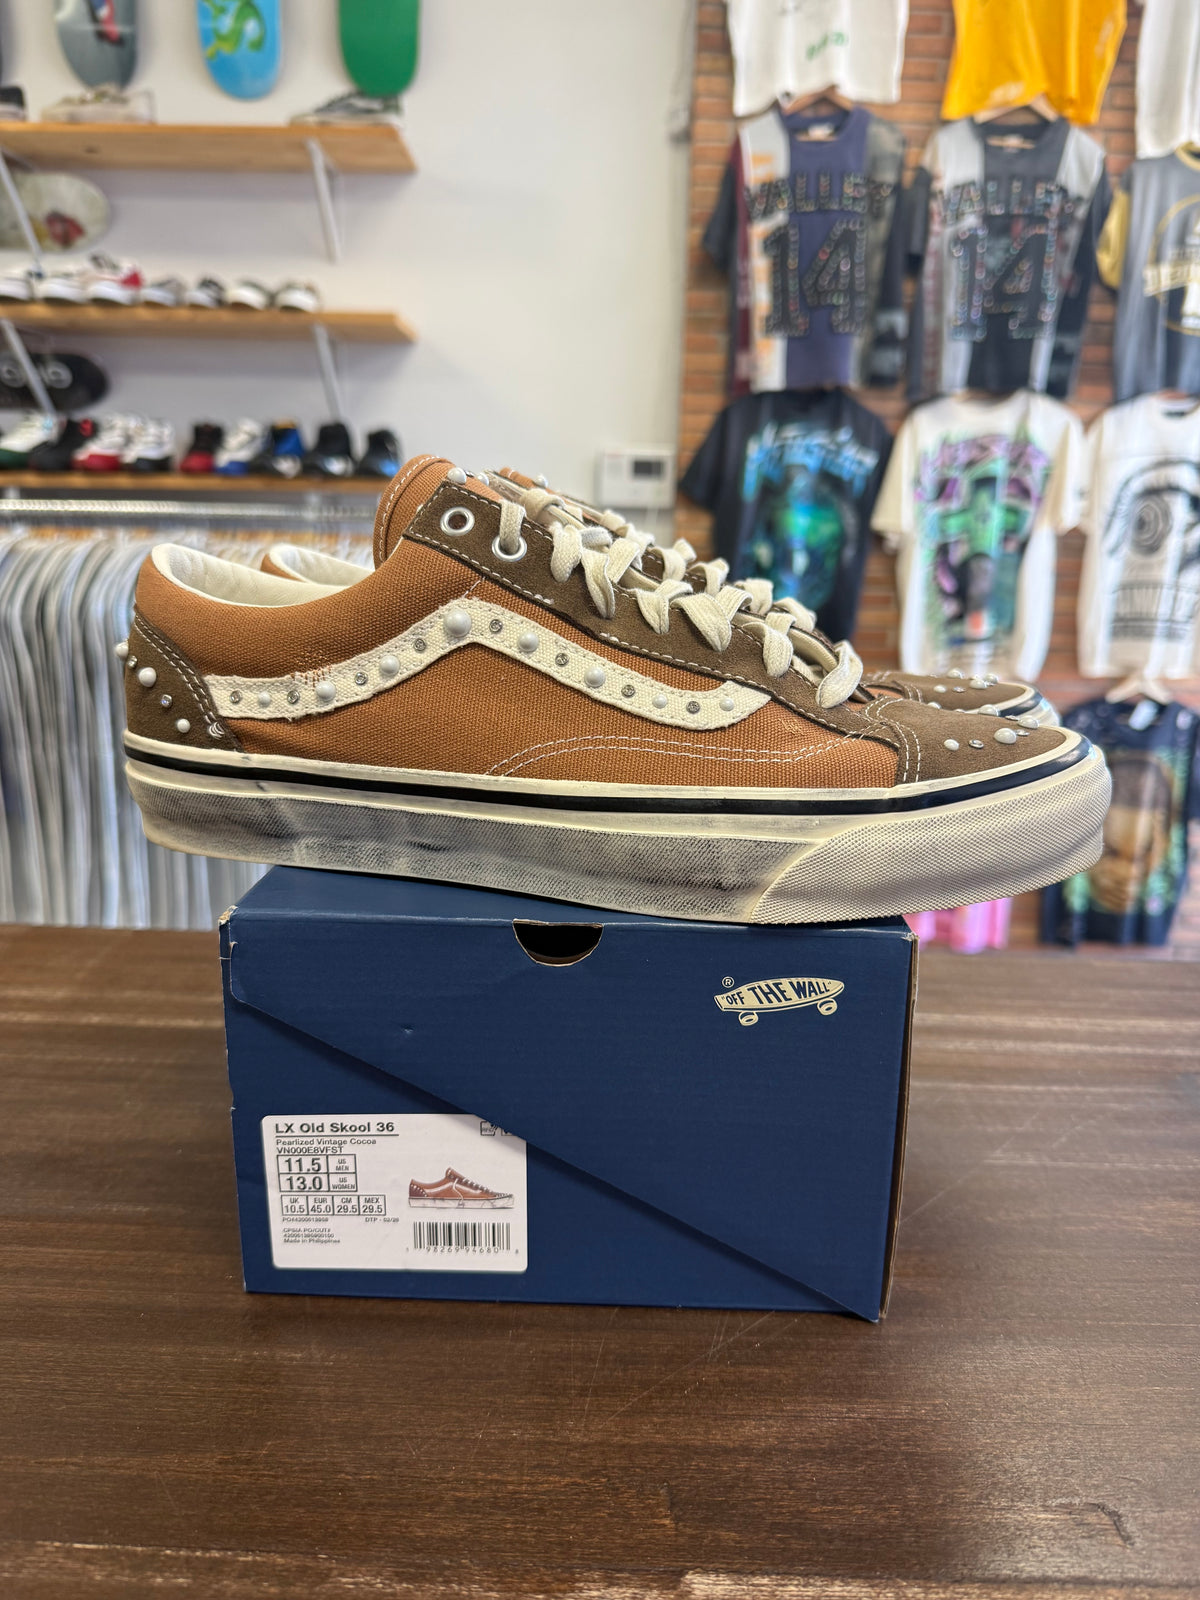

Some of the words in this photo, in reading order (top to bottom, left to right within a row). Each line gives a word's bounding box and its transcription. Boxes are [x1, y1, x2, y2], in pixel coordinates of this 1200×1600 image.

[764, 218, 869, 337] 14
[951, 225, 1058, 341] 14
[747, 981, 792, 1004] THE
[275, 1123, 295, 1133] LX
[300, 1122, 325, 1133] Old
[330, 1122, 371, 1133] Skool
[376, 1122, 395, 1132] 36
[276, 1138, 315, 1146] Pearlized
[316, 1138, 348, 1146] Vintage
[276, 1146, 344, 1154] VN000E8VFST
[285, 1157, 322, 1172] 11.5
[286, 1176, 323, 1190] 13.0
[284, 1204, 305, 1213] 10.5
[310, 1204, 332, 1213] 45.0
[336, 1204, 358, 1213] 29.5
[362, 1204, 383, 1213] 29.5
